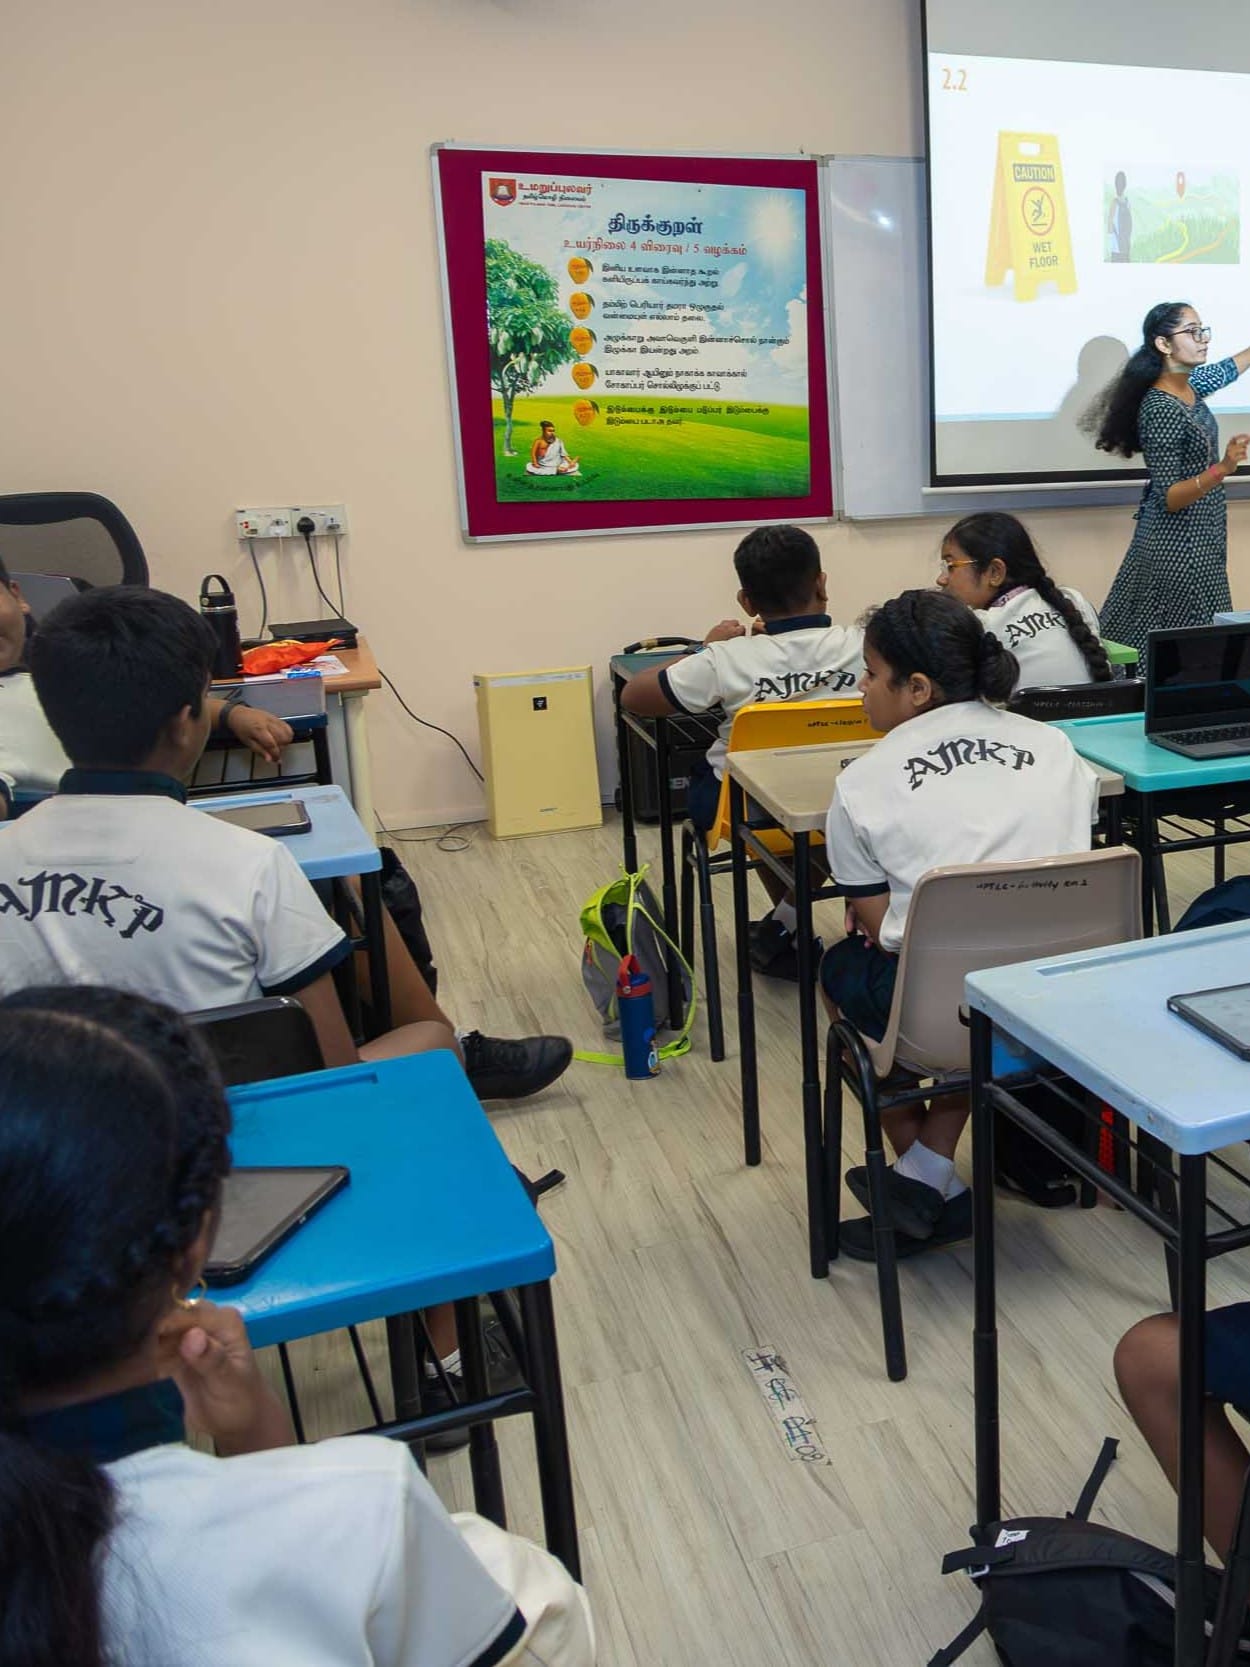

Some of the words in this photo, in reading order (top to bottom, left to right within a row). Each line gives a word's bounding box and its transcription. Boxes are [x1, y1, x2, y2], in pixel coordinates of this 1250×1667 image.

[942, 68, 967, 91] 2.2
[1015, 166, 1054, 180] CAUTION
[608, 213, 703, 237] திருக்குறள்
[563, 237, 626, 253] உயர்நிலை
[630, 240, 637, 249] 4
[640, 240, 683, 255] விரைவு
[693, 243, 700, 253] 5
[703, 243, 748, 257] வழக்கம்
[1033, 242, 1052, 253] WET
[1029, 255, 1058, 268] FLOOR
[1005, 611, 1066, 648] AMK
